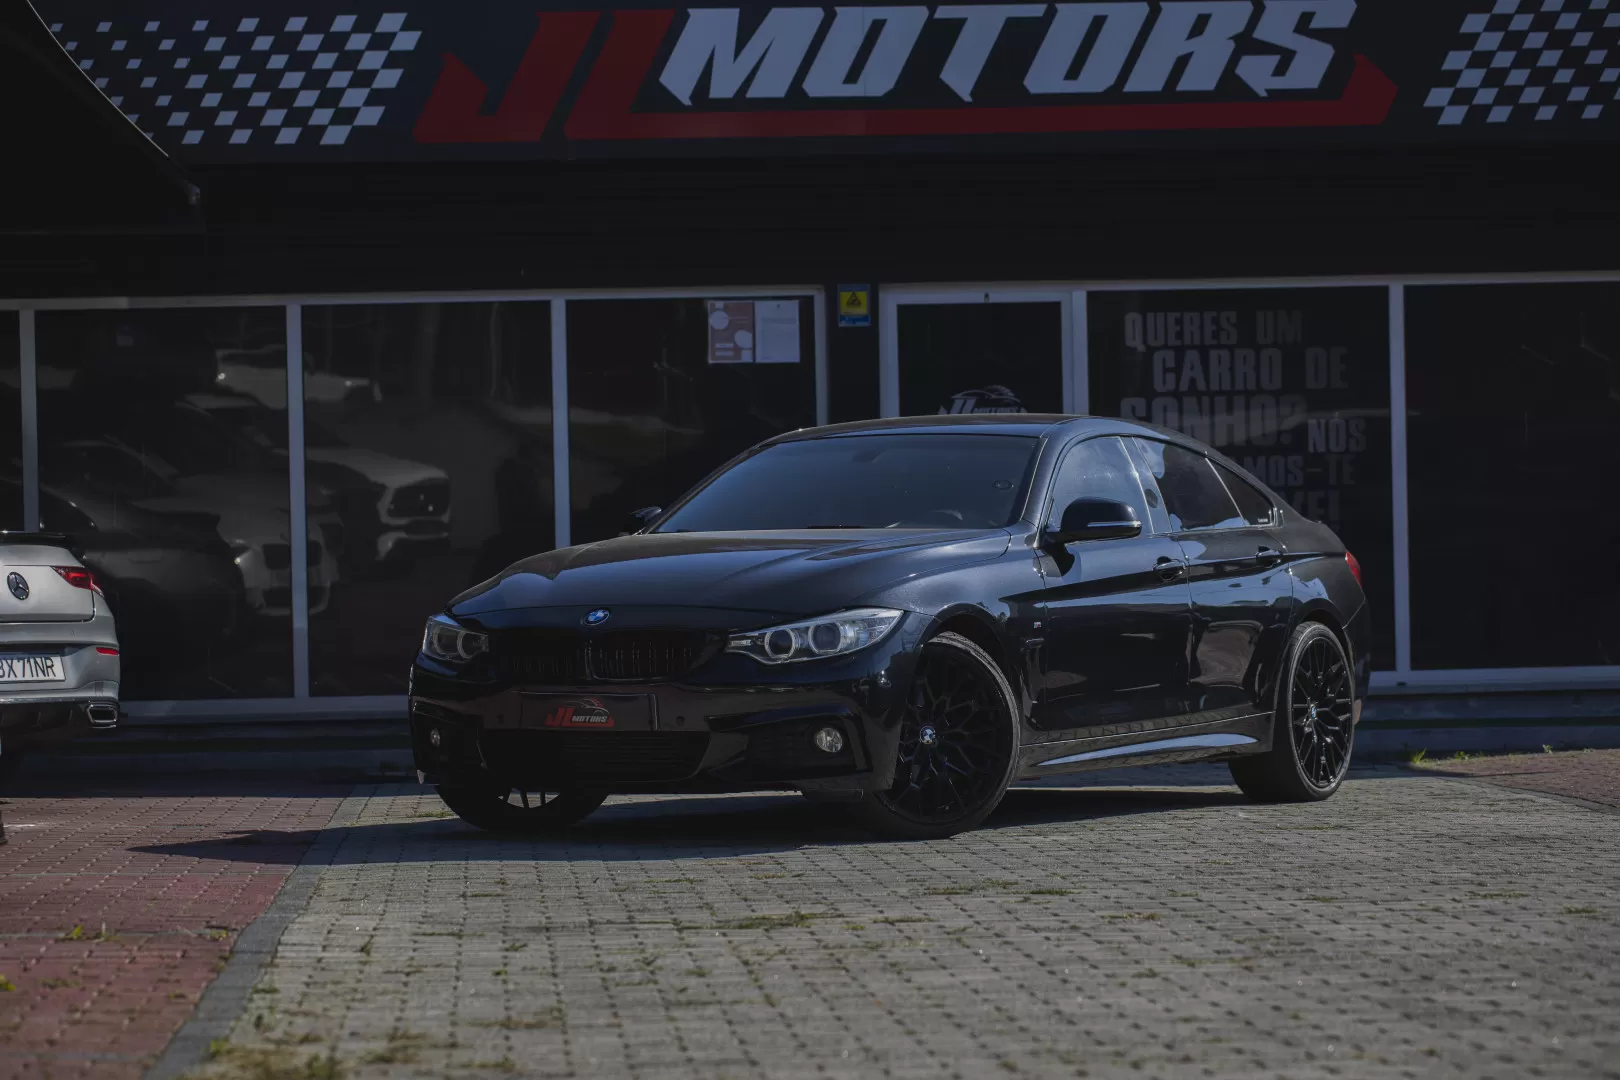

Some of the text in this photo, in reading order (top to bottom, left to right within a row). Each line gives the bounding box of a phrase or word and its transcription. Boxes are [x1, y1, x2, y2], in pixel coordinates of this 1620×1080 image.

[412, 0, 1357, 144] JL MOTORS
[1124, 309, 1303, 352] QUERES UM
[1152, 346, 1349, 393] CARRO DE
[1231, 454, 1356, 488] MOS-TE
[544, 707, 577, 728] JL
